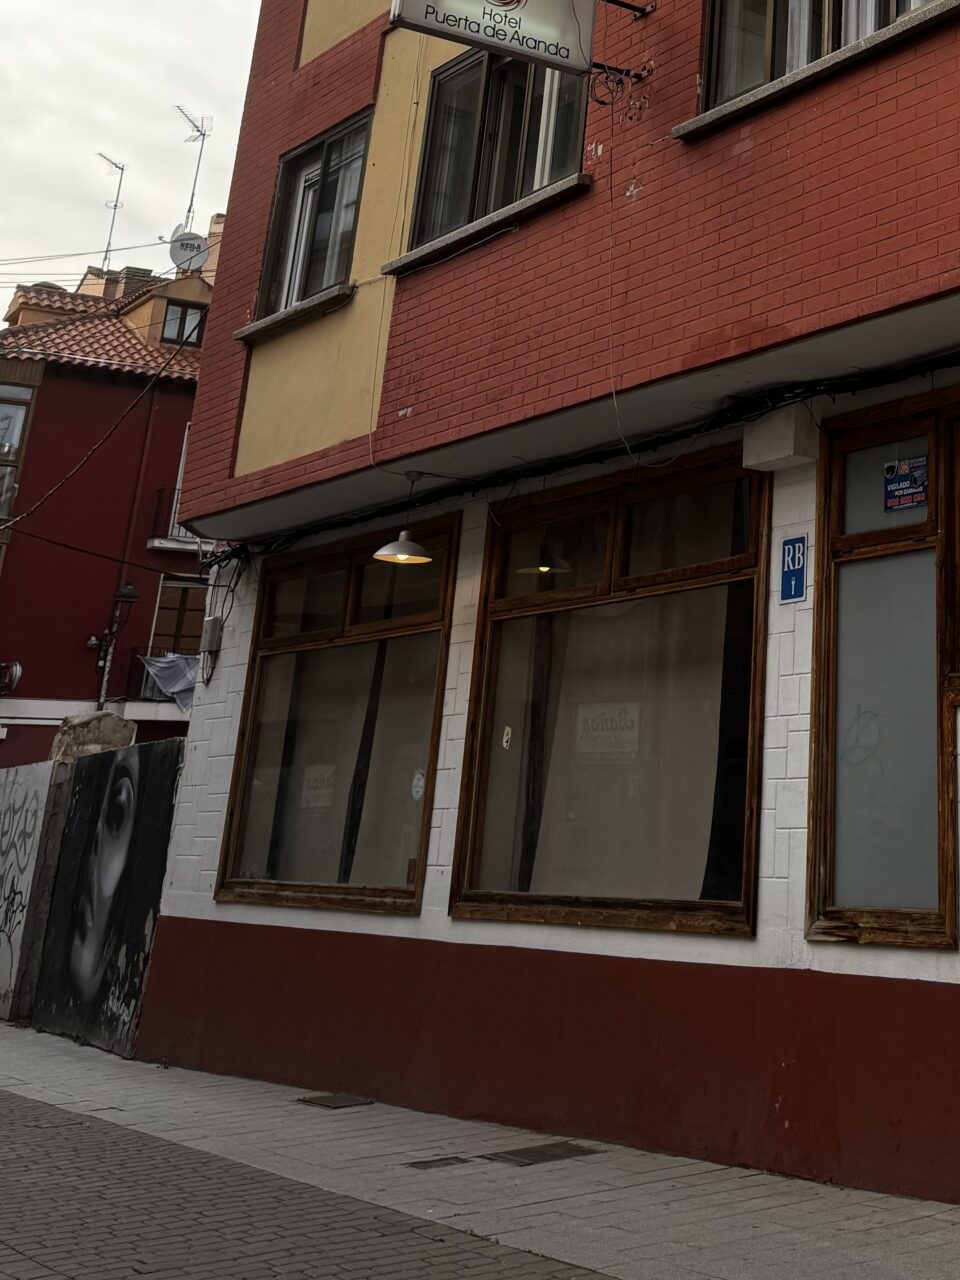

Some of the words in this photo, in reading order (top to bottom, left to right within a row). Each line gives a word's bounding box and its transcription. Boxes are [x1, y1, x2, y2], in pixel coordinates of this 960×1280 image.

[424, 4, 480, 34] Puerta
[484, 24, 507, 41] de
[510, 30, 569, 59] Aranda
[482, 6, 521, 30] Hotel
[783, 542, 804, 572] RB
